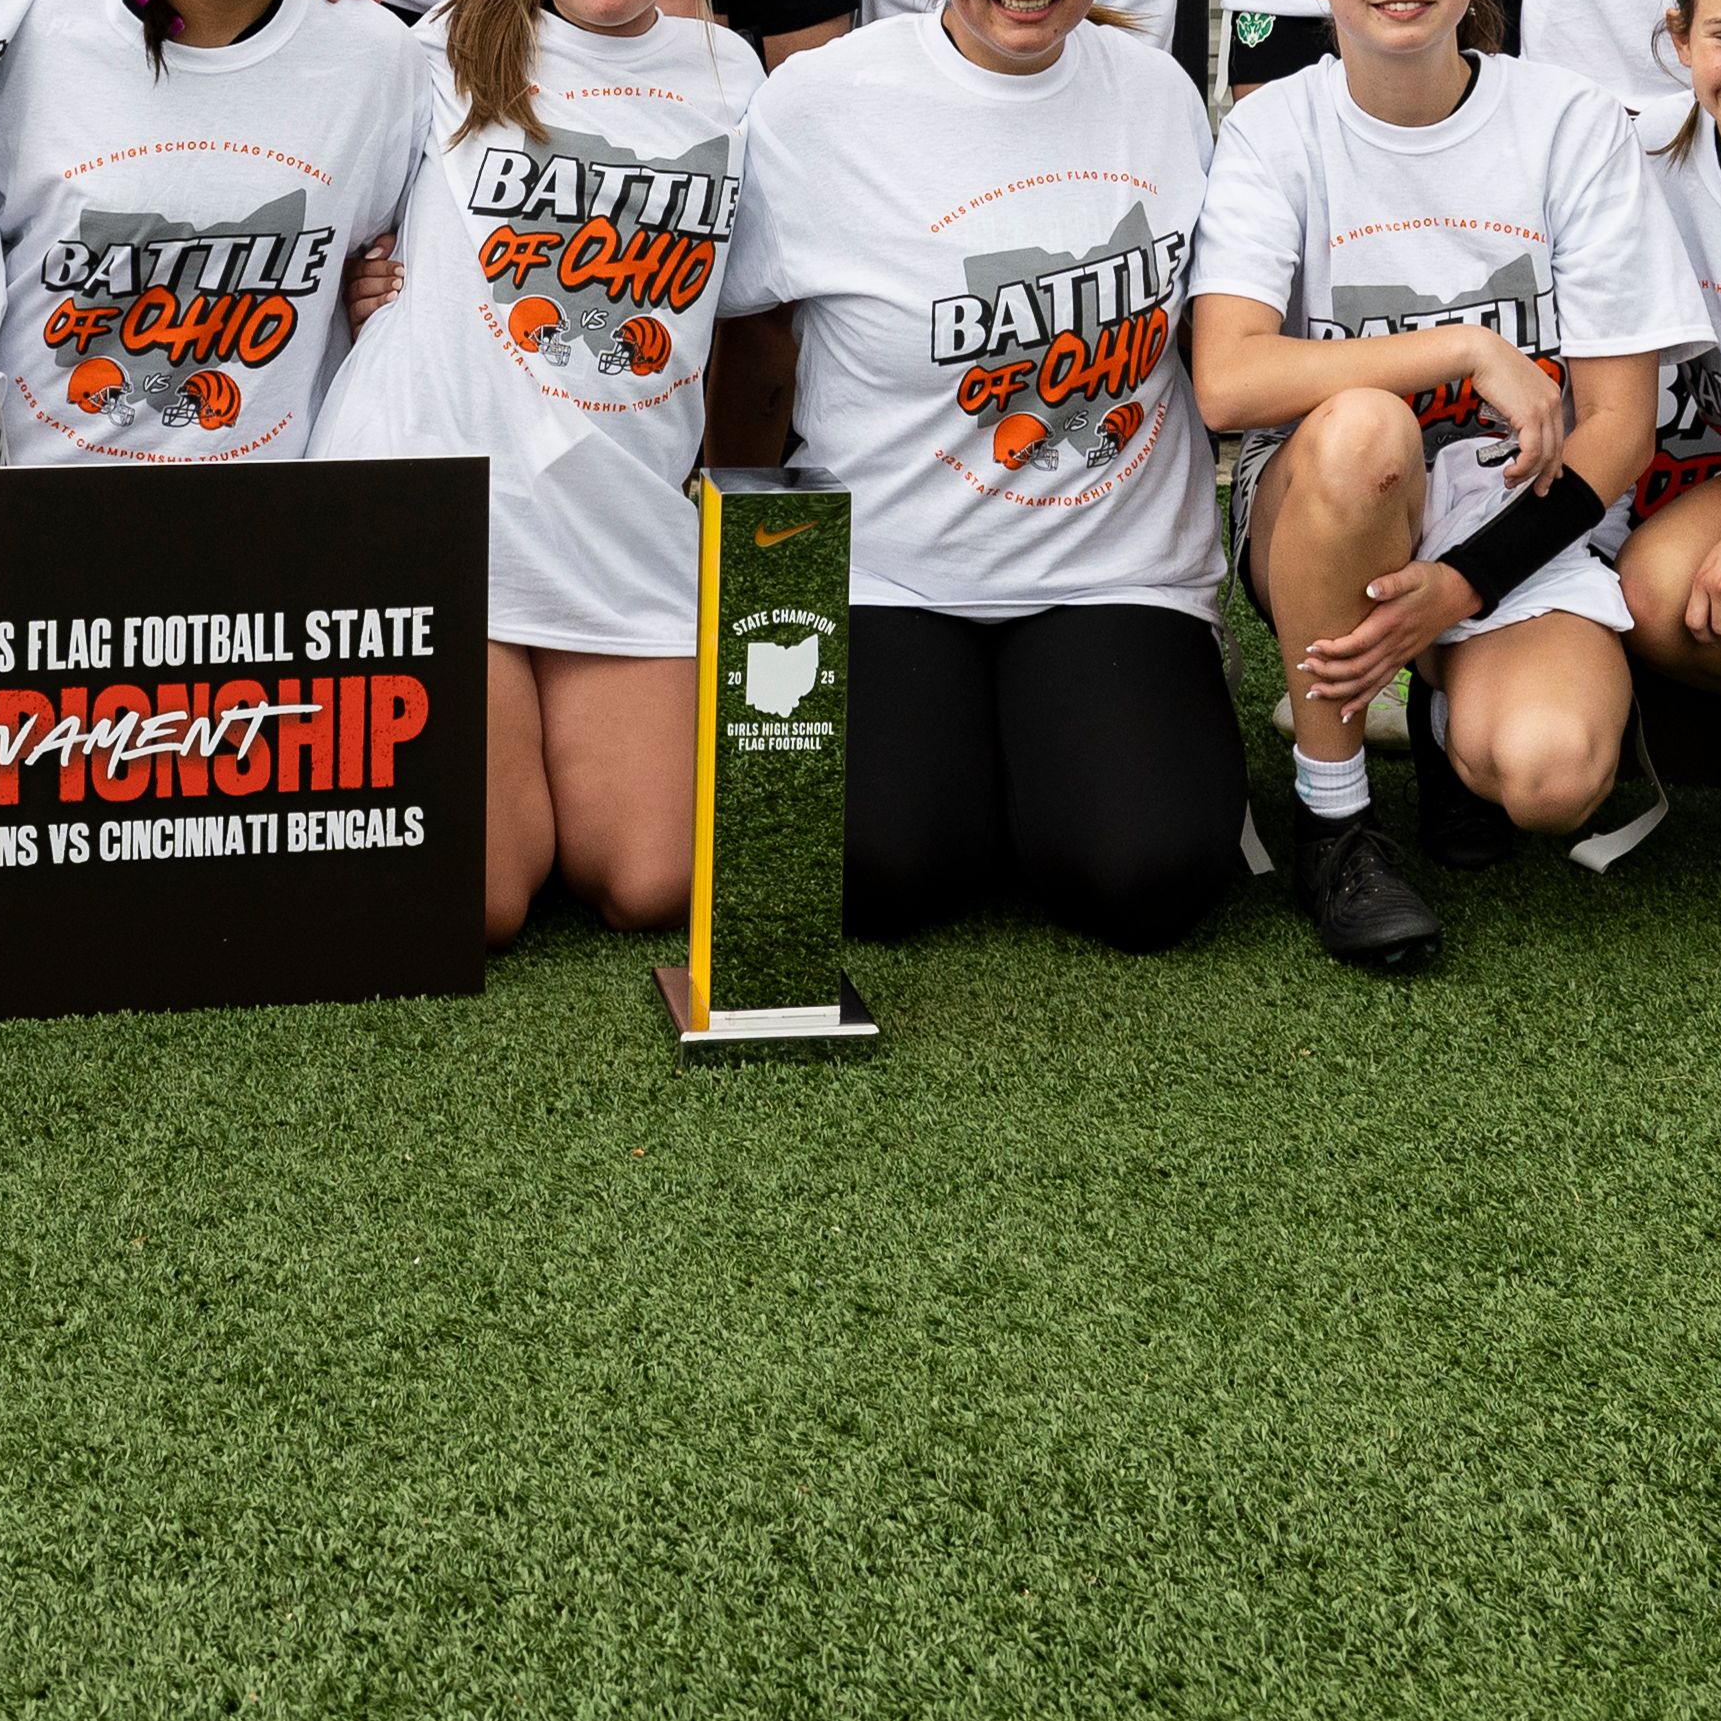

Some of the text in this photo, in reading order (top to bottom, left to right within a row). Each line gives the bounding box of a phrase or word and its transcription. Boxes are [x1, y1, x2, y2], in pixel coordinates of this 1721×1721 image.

[64, 140, 333, 187] GIRLS HIGH SCHOOL FLAG FOOTBALL
[467, 147, 741, 242] BATTLE
[930, 205, 967, 233] GIRLS
[969, 188, 1003, 209] HIGH
[1008, 173, 1062, 193] SCHOOL
[1067, 171, 1098, 181] FLAG
[41, 226, 335, 300] BATTLE
[478, 215, 716, 314] OF OHIO
[43, 284, 298, 368] OF OHIO
[931, 231, 1185, 366] BATTLE
[957, 306, 1169, 417] OF OHIO
[14, 376, 37, 409] 2025
[36, 410, 76, 440] STATE
[199, 411, 295, 463] TOURNAMENT
[1004, 401, 1167, 508] CHAMPIONSHIP TOURNAMENT
[27, 618, 112, 672] FLAG
[123, 612, 293, 667] FOOTBALL
[304, 607, 434, 660] STATE
[733, 609, 836, 636] STATE CHAMPION
[728, 671, 834, 684] 20 25
[727, 722, 834, 736] GIRLS HIGH SCHOOL
[739, 737, 821, 750] FLAG FOOTBALL
[48, 822, 90, 864] VS
[98, 814, 278, 862] CINCINNATI
[287, 807, 424, 853] BENGALS
